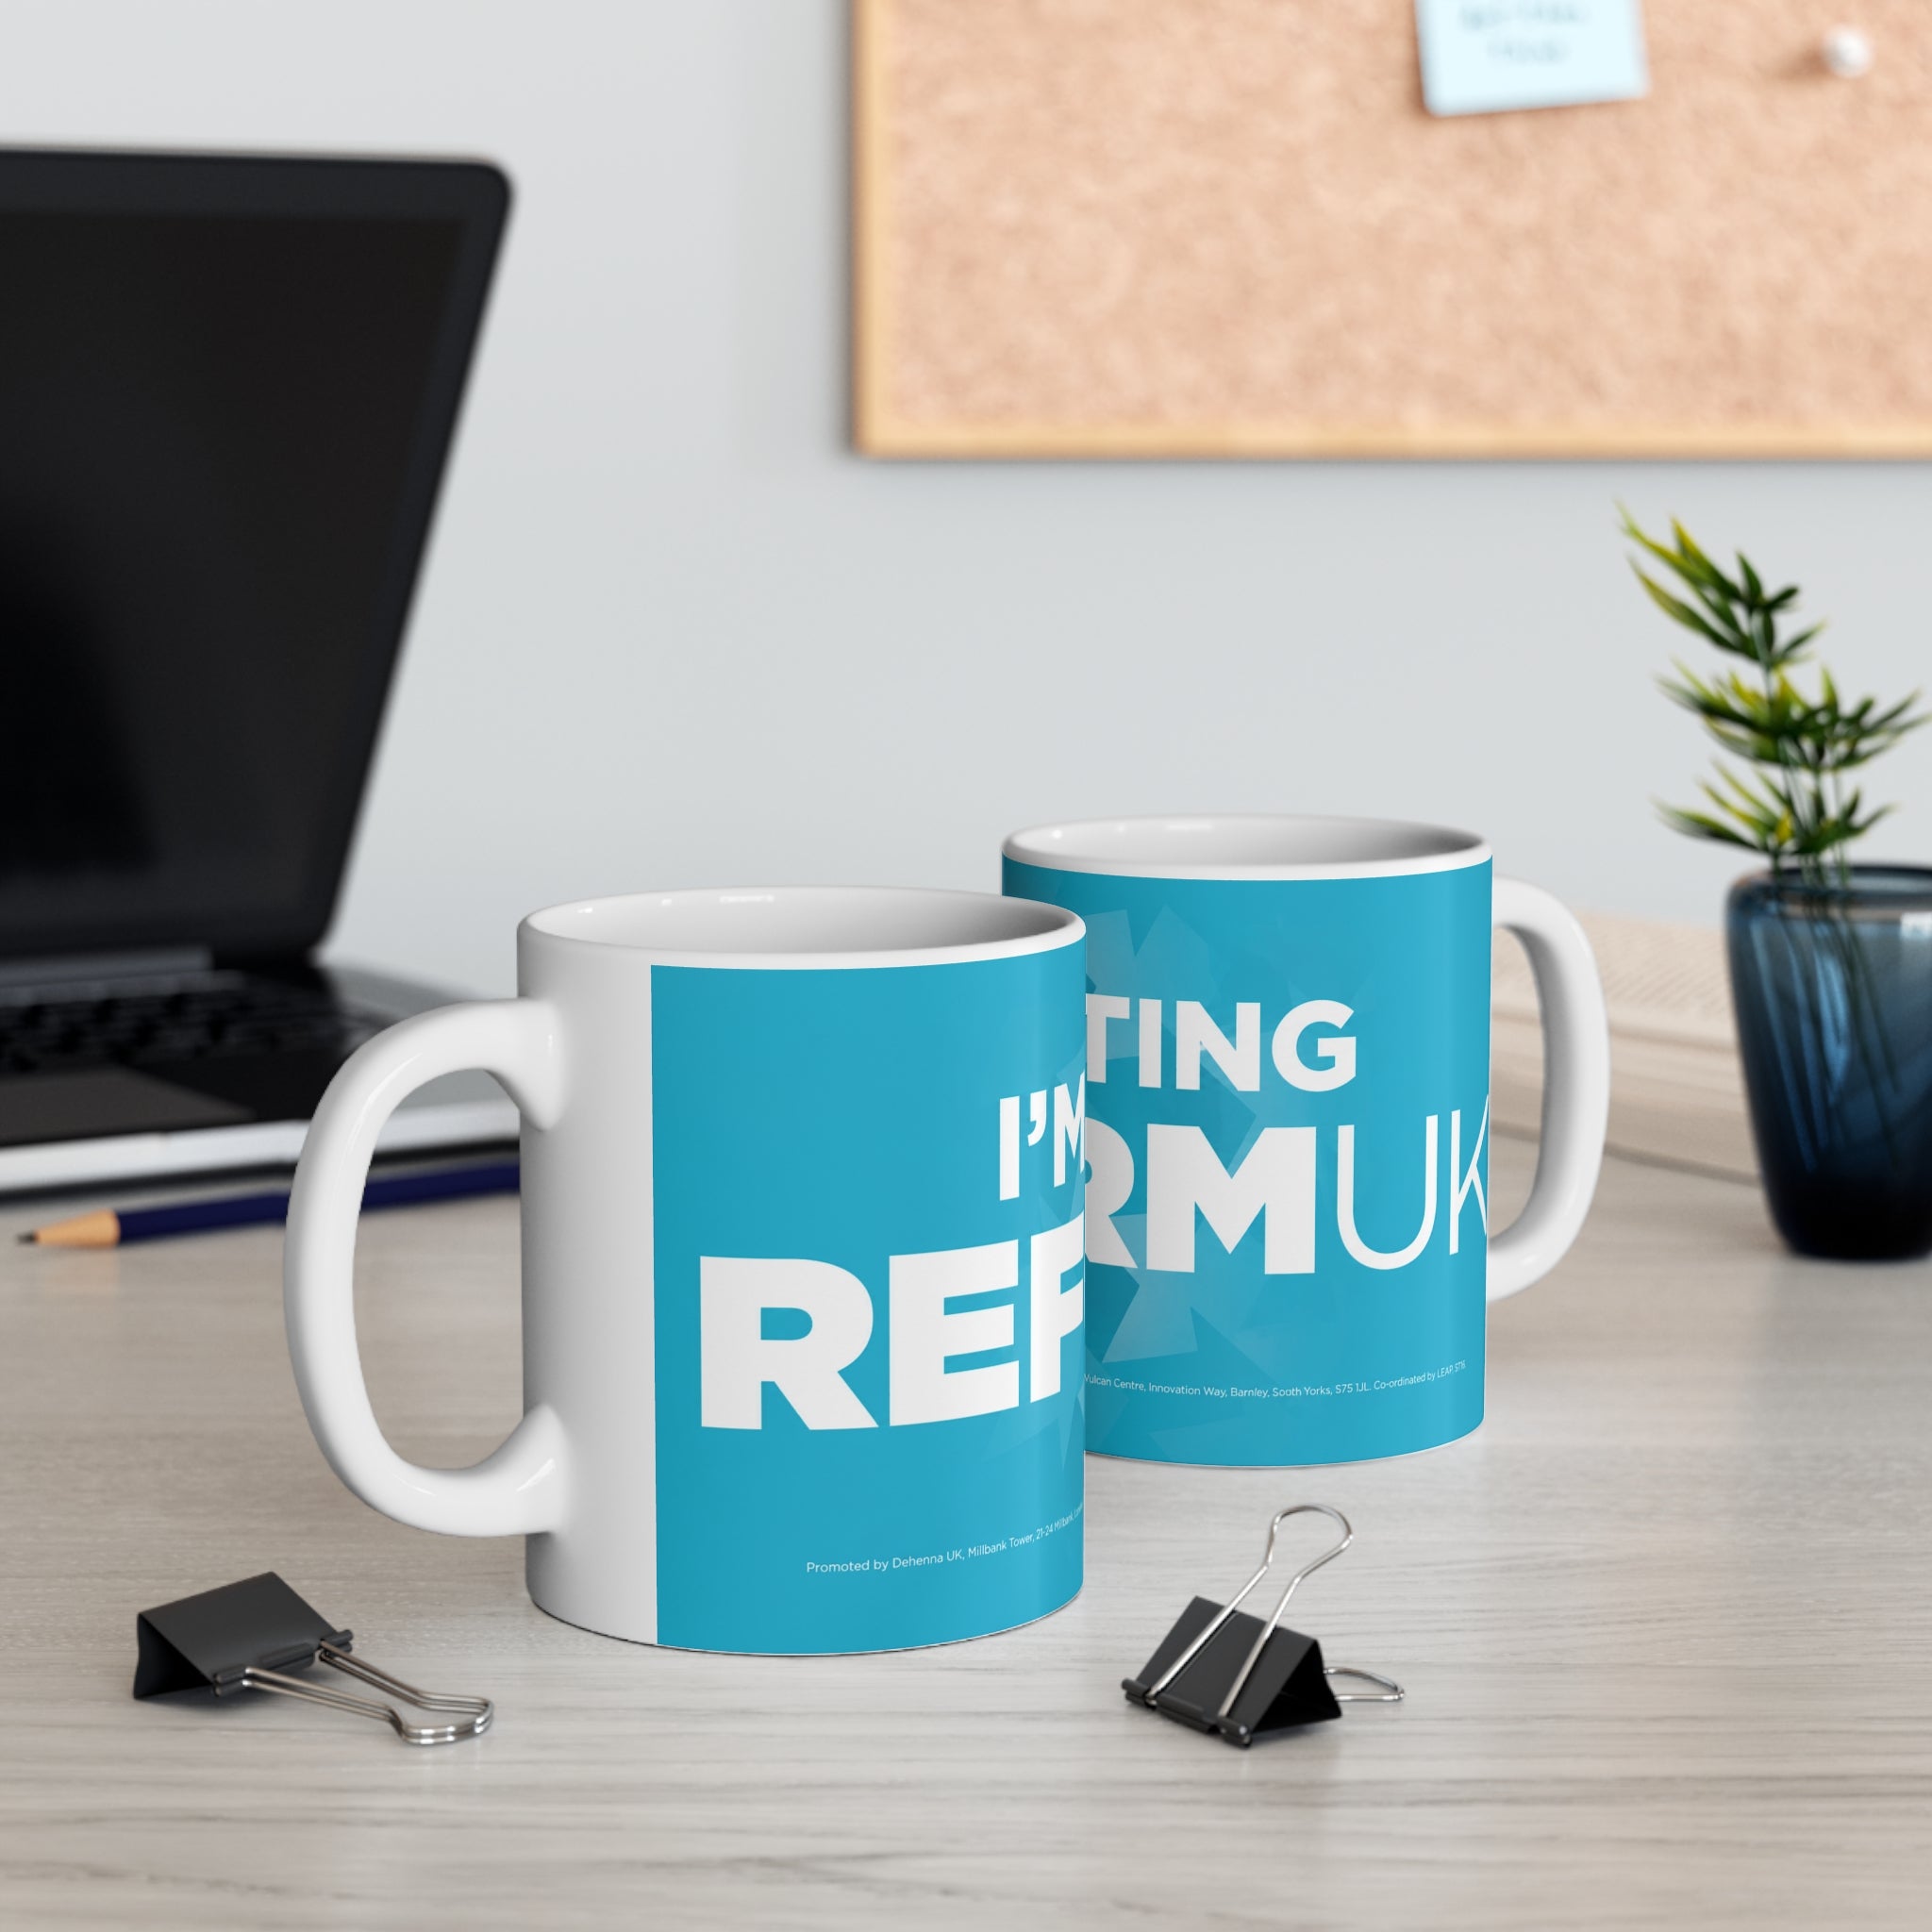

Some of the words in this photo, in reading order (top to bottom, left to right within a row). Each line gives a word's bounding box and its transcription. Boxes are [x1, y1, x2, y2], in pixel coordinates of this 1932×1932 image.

[1085, 993, 1357, 1092] TING
[700, 1209, 1085, 1431] REF
[1084, 1373, 1111, 1387] Vulcan
[1113, 1377, 1146, 1391] Centre,
[1148, 1382, 1201, 1396] Innovation
[1203, 1386, 1227, 1398] Way,
[1335, 1382, 1354, 1394] S75
[1374, 1372, 1426, 1391] Co-ordinated
[1427, 1371, 1436, 1382] by
[807, 1559, 870, 1574] Promoted
[873, 1559, 890, 1572] by
[892, 1555, 943, 1569] Dehenna
[946, 1548, 965, 1562] UK,
[968, 1540, 1008, 1558] Millbank
[1008, 1532, 1035, 1548] Tower,
[1036, 1522, 1054, 1541] 21-24
